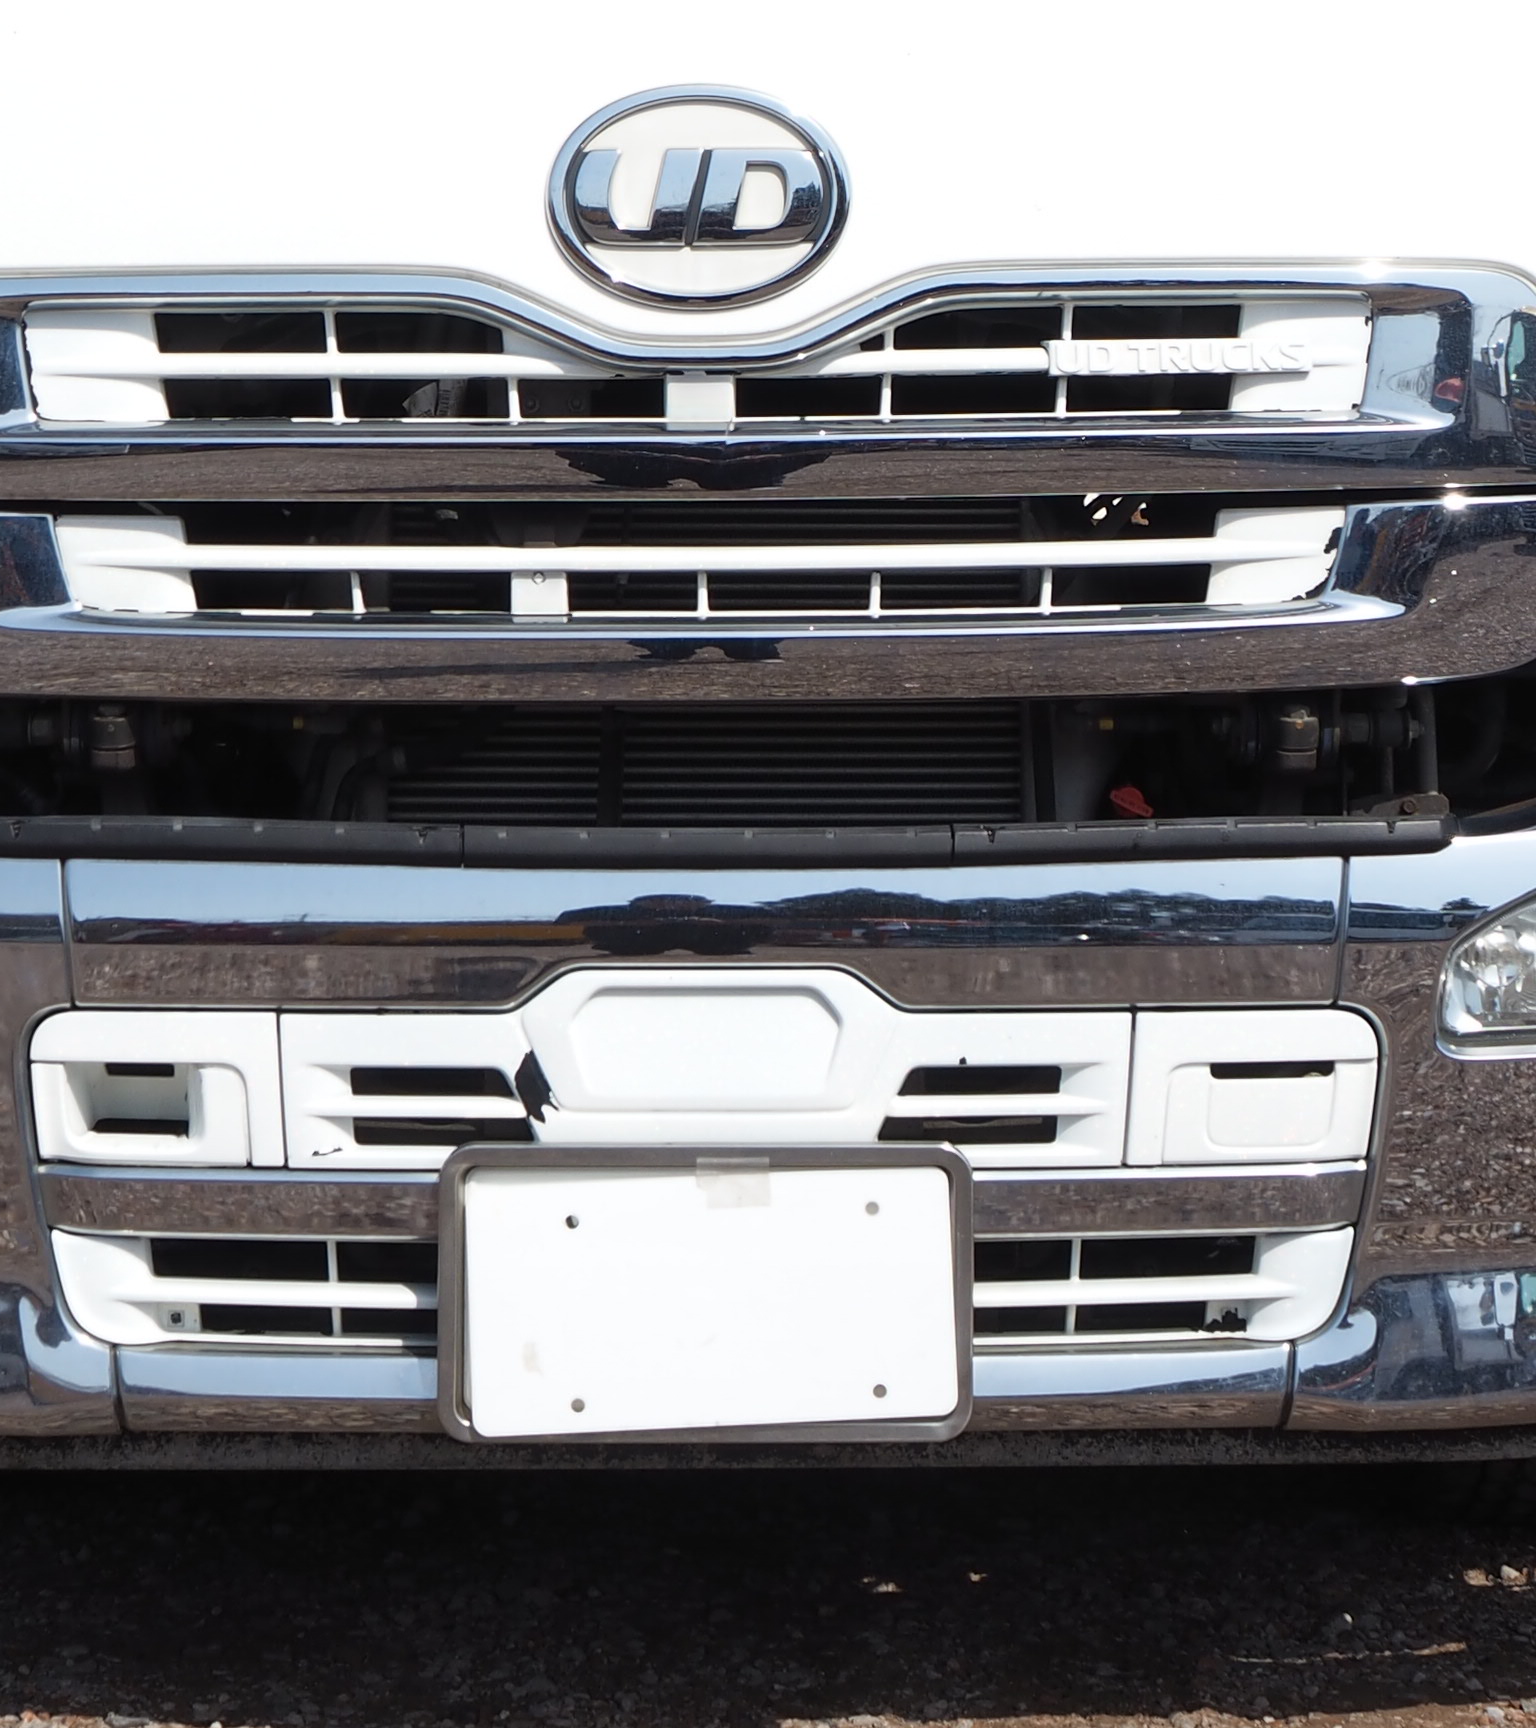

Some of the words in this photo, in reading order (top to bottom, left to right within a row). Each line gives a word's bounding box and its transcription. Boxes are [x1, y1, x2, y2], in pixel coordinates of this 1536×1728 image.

[574, 147, 824, 245] UD
[1055, 343, 1111, 373] UD
[1127, 343, 1306, 372] TRUCKS
